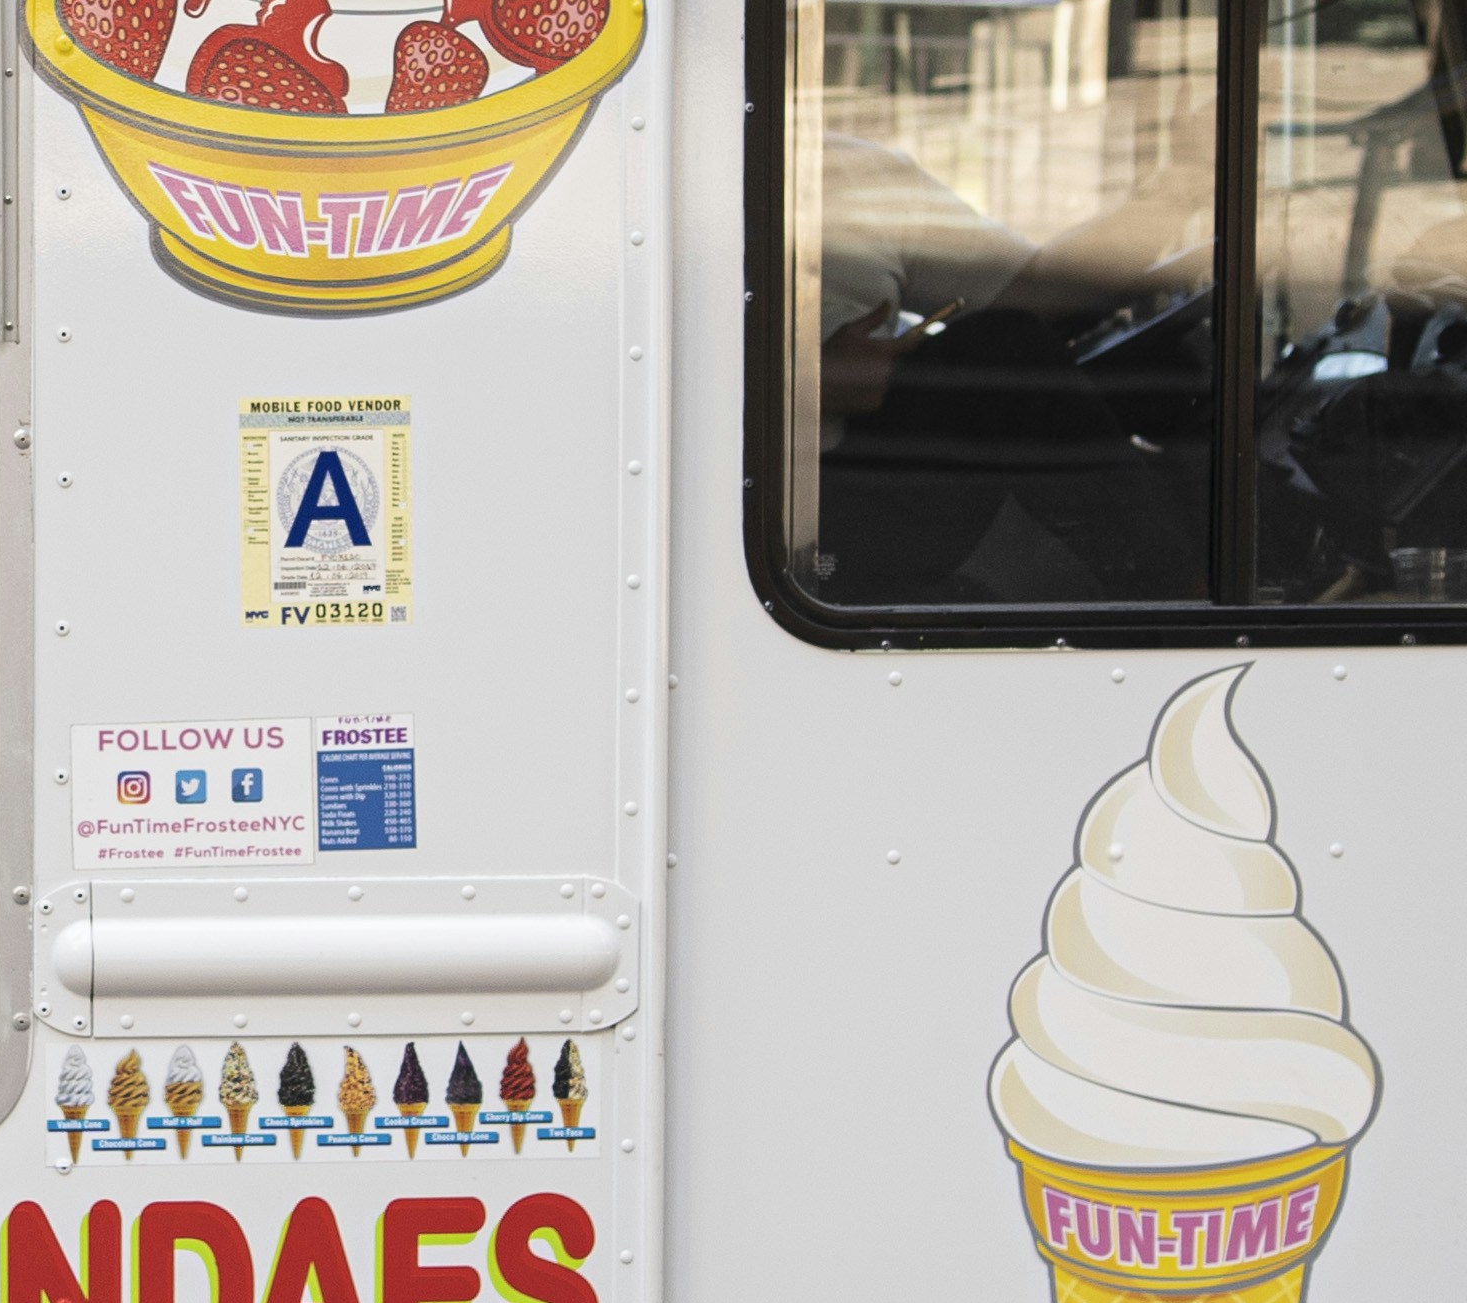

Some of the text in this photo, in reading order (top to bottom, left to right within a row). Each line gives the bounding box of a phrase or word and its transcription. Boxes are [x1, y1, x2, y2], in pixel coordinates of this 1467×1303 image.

[148, 162, 513, 259] FUN-TIME
[250, 400, 401, 413] MOBILE FOOD VENDOR
[284, 451, 372, 548] A
[281, 603, 383, 625] FV 03120
[99, 727, 284, 752] FOLLOW US
[322, 728, 407, 746] FROSTEE
[78, 816, 305, 837] @FunTimeFrosteeNYC
[99, 845, 301, 859] #Frostee #FunTimeFrostee
[57, 1121, 102, 1129] Vanilla Cone
[549, 1129, 583, 1137] Two Face
[360, 1135, 378, 1143] Cone
[1043, 1185, 1319, 1270] FUN-TIME
